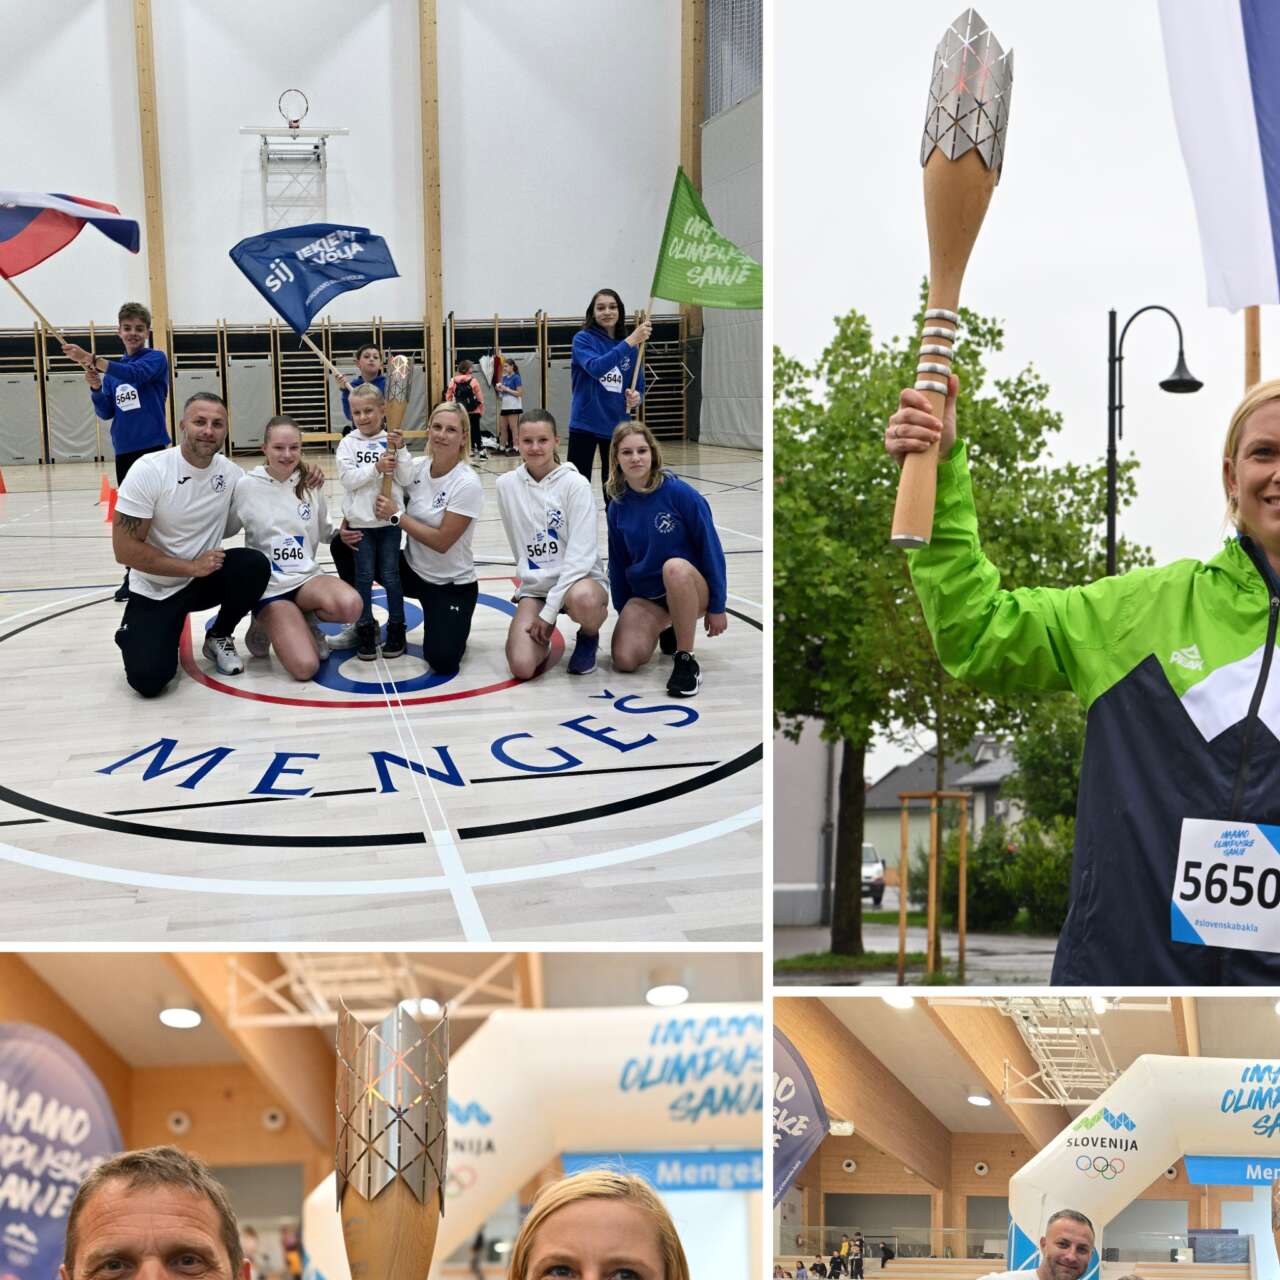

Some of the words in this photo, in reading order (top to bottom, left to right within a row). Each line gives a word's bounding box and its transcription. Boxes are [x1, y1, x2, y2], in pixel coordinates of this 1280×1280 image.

[265, 258, 295, 293] sij
[686, 264, 752, 288] SANJE
[116, 390, 137, 405] 5645
[356, 451, 380, 464] 565
[273, 547, 304, 561] 5646
[95, 687, 701, 796] MENGEŠ
[1195, 919, 1259, 933] #slovenskabakla
[650, 1013, 763, 1046] IMAM
[0, 1080, 91, 1146] MAMO
[1066, 1137, 1139, 1152] SLOVENIJA
[0, 1173, 75, 1218] ANJE
